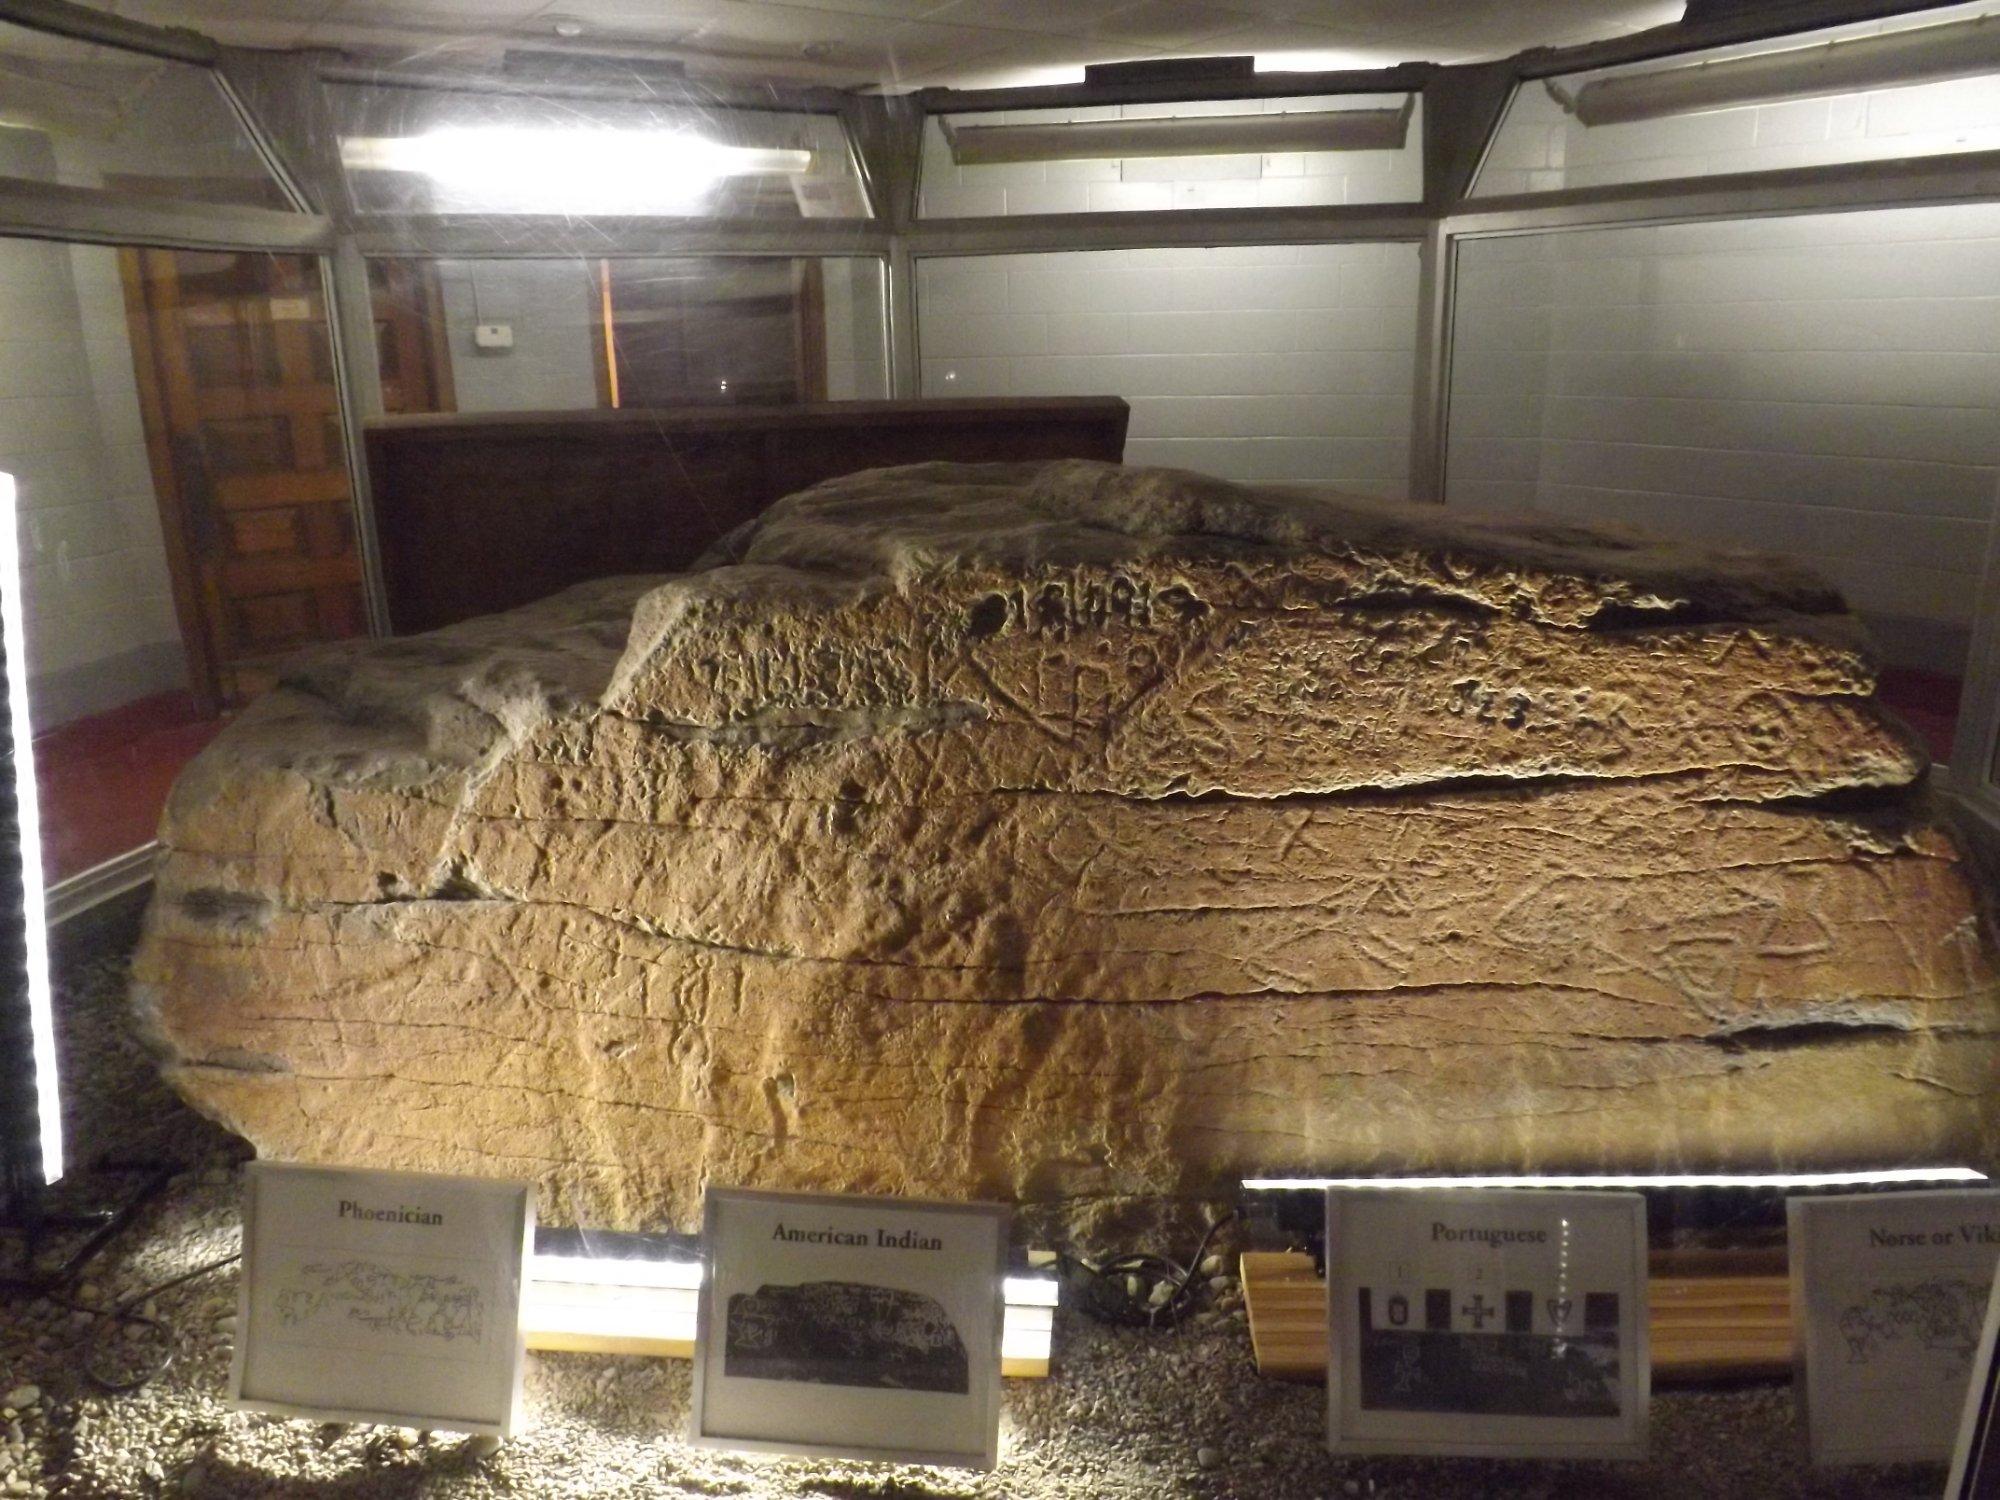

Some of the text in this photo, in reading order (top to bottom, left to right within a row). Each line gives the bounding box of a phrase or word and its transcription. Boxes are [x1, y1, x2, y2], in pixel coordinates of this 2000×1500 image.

[339, 1200, 442, 1225] Phoenician
[772, 1223, 942, 1250] American Indian
[1432, 1222, 1547, 1247] Portuguese
[1869, 1228, 1926, 1248] Norse
[1931, 1232, 1954, 1246] or
